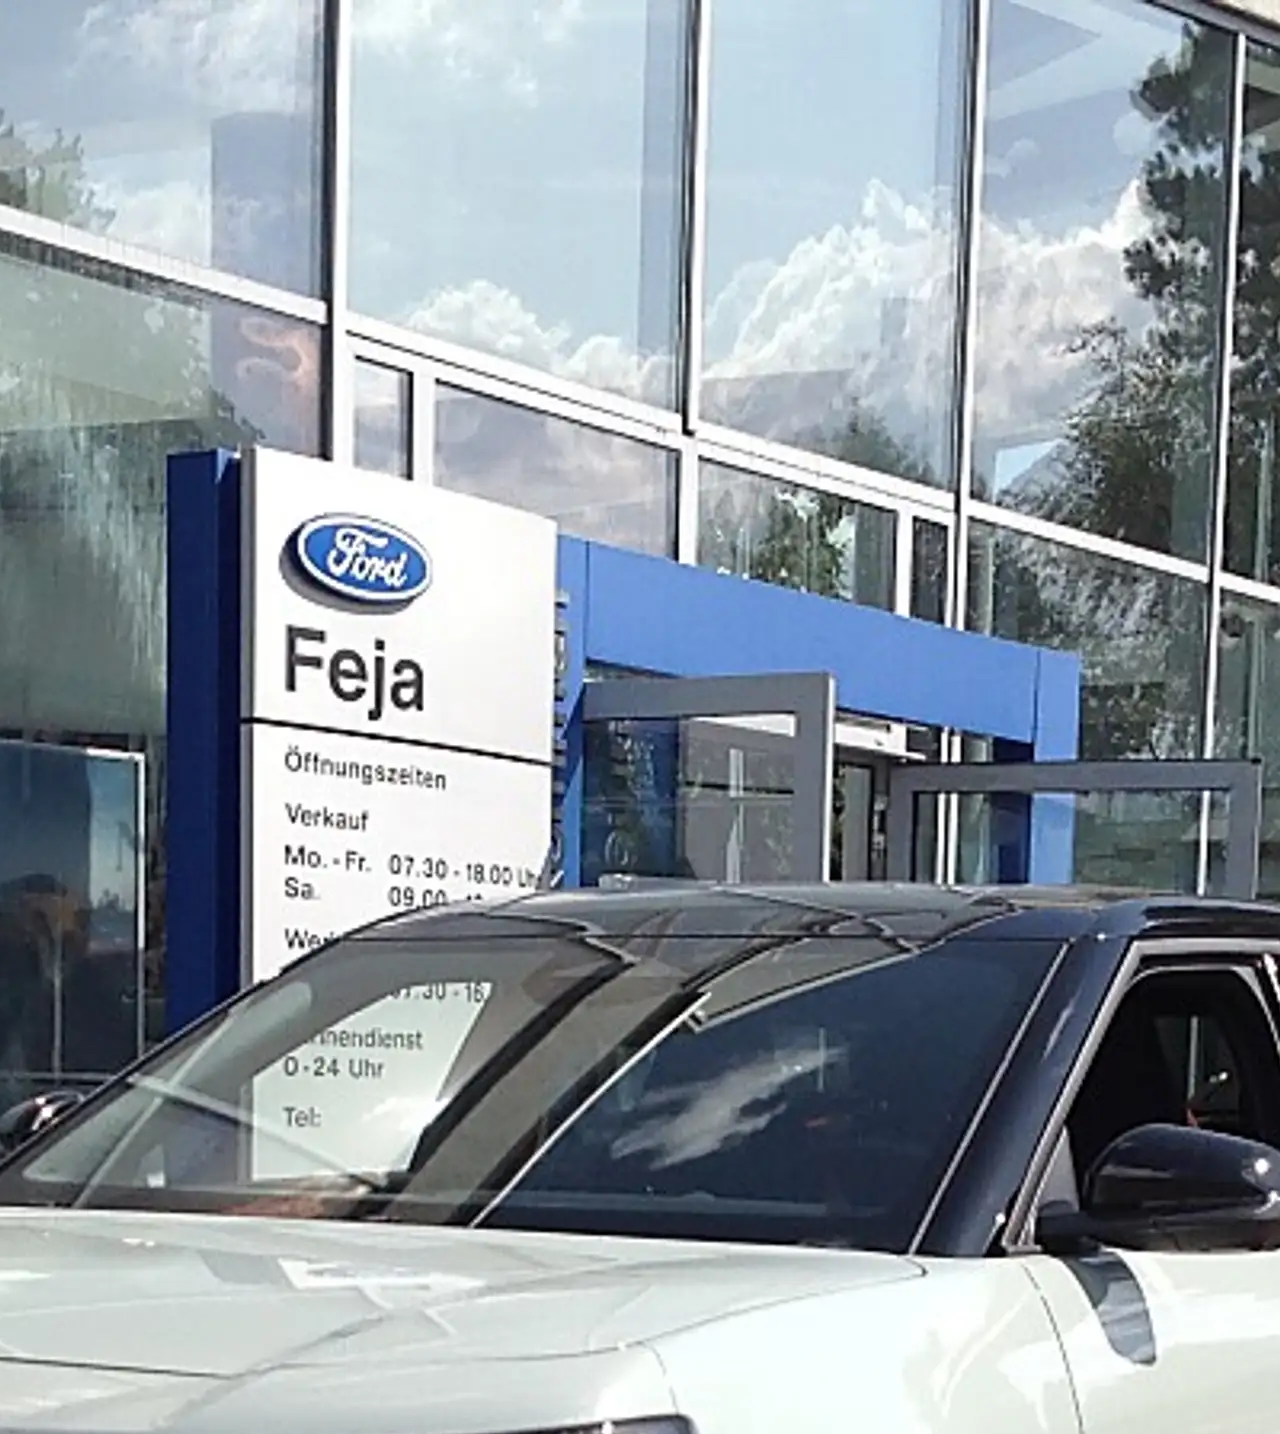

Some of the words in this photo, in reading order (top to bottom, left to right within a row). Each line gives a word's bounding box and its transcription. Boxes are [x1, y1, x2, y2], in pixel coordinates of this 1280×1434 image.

[327, 527, 409, 588] Ford
[285, 624, 424, 721] Feja
[284, 744, 447, 790] Öffnungszeiten
[284, 802, 369, 832] Verkauf
[284, 844, 328, 869] Mo.
[345, 848, 372, 874] Fr.
[388, 853, 449, 881] 07.30
[466, 863, 514, 888] 18.00
[284, 876, 320, 900] Sa.
[348, 1058, 385, 1080] Uhr
